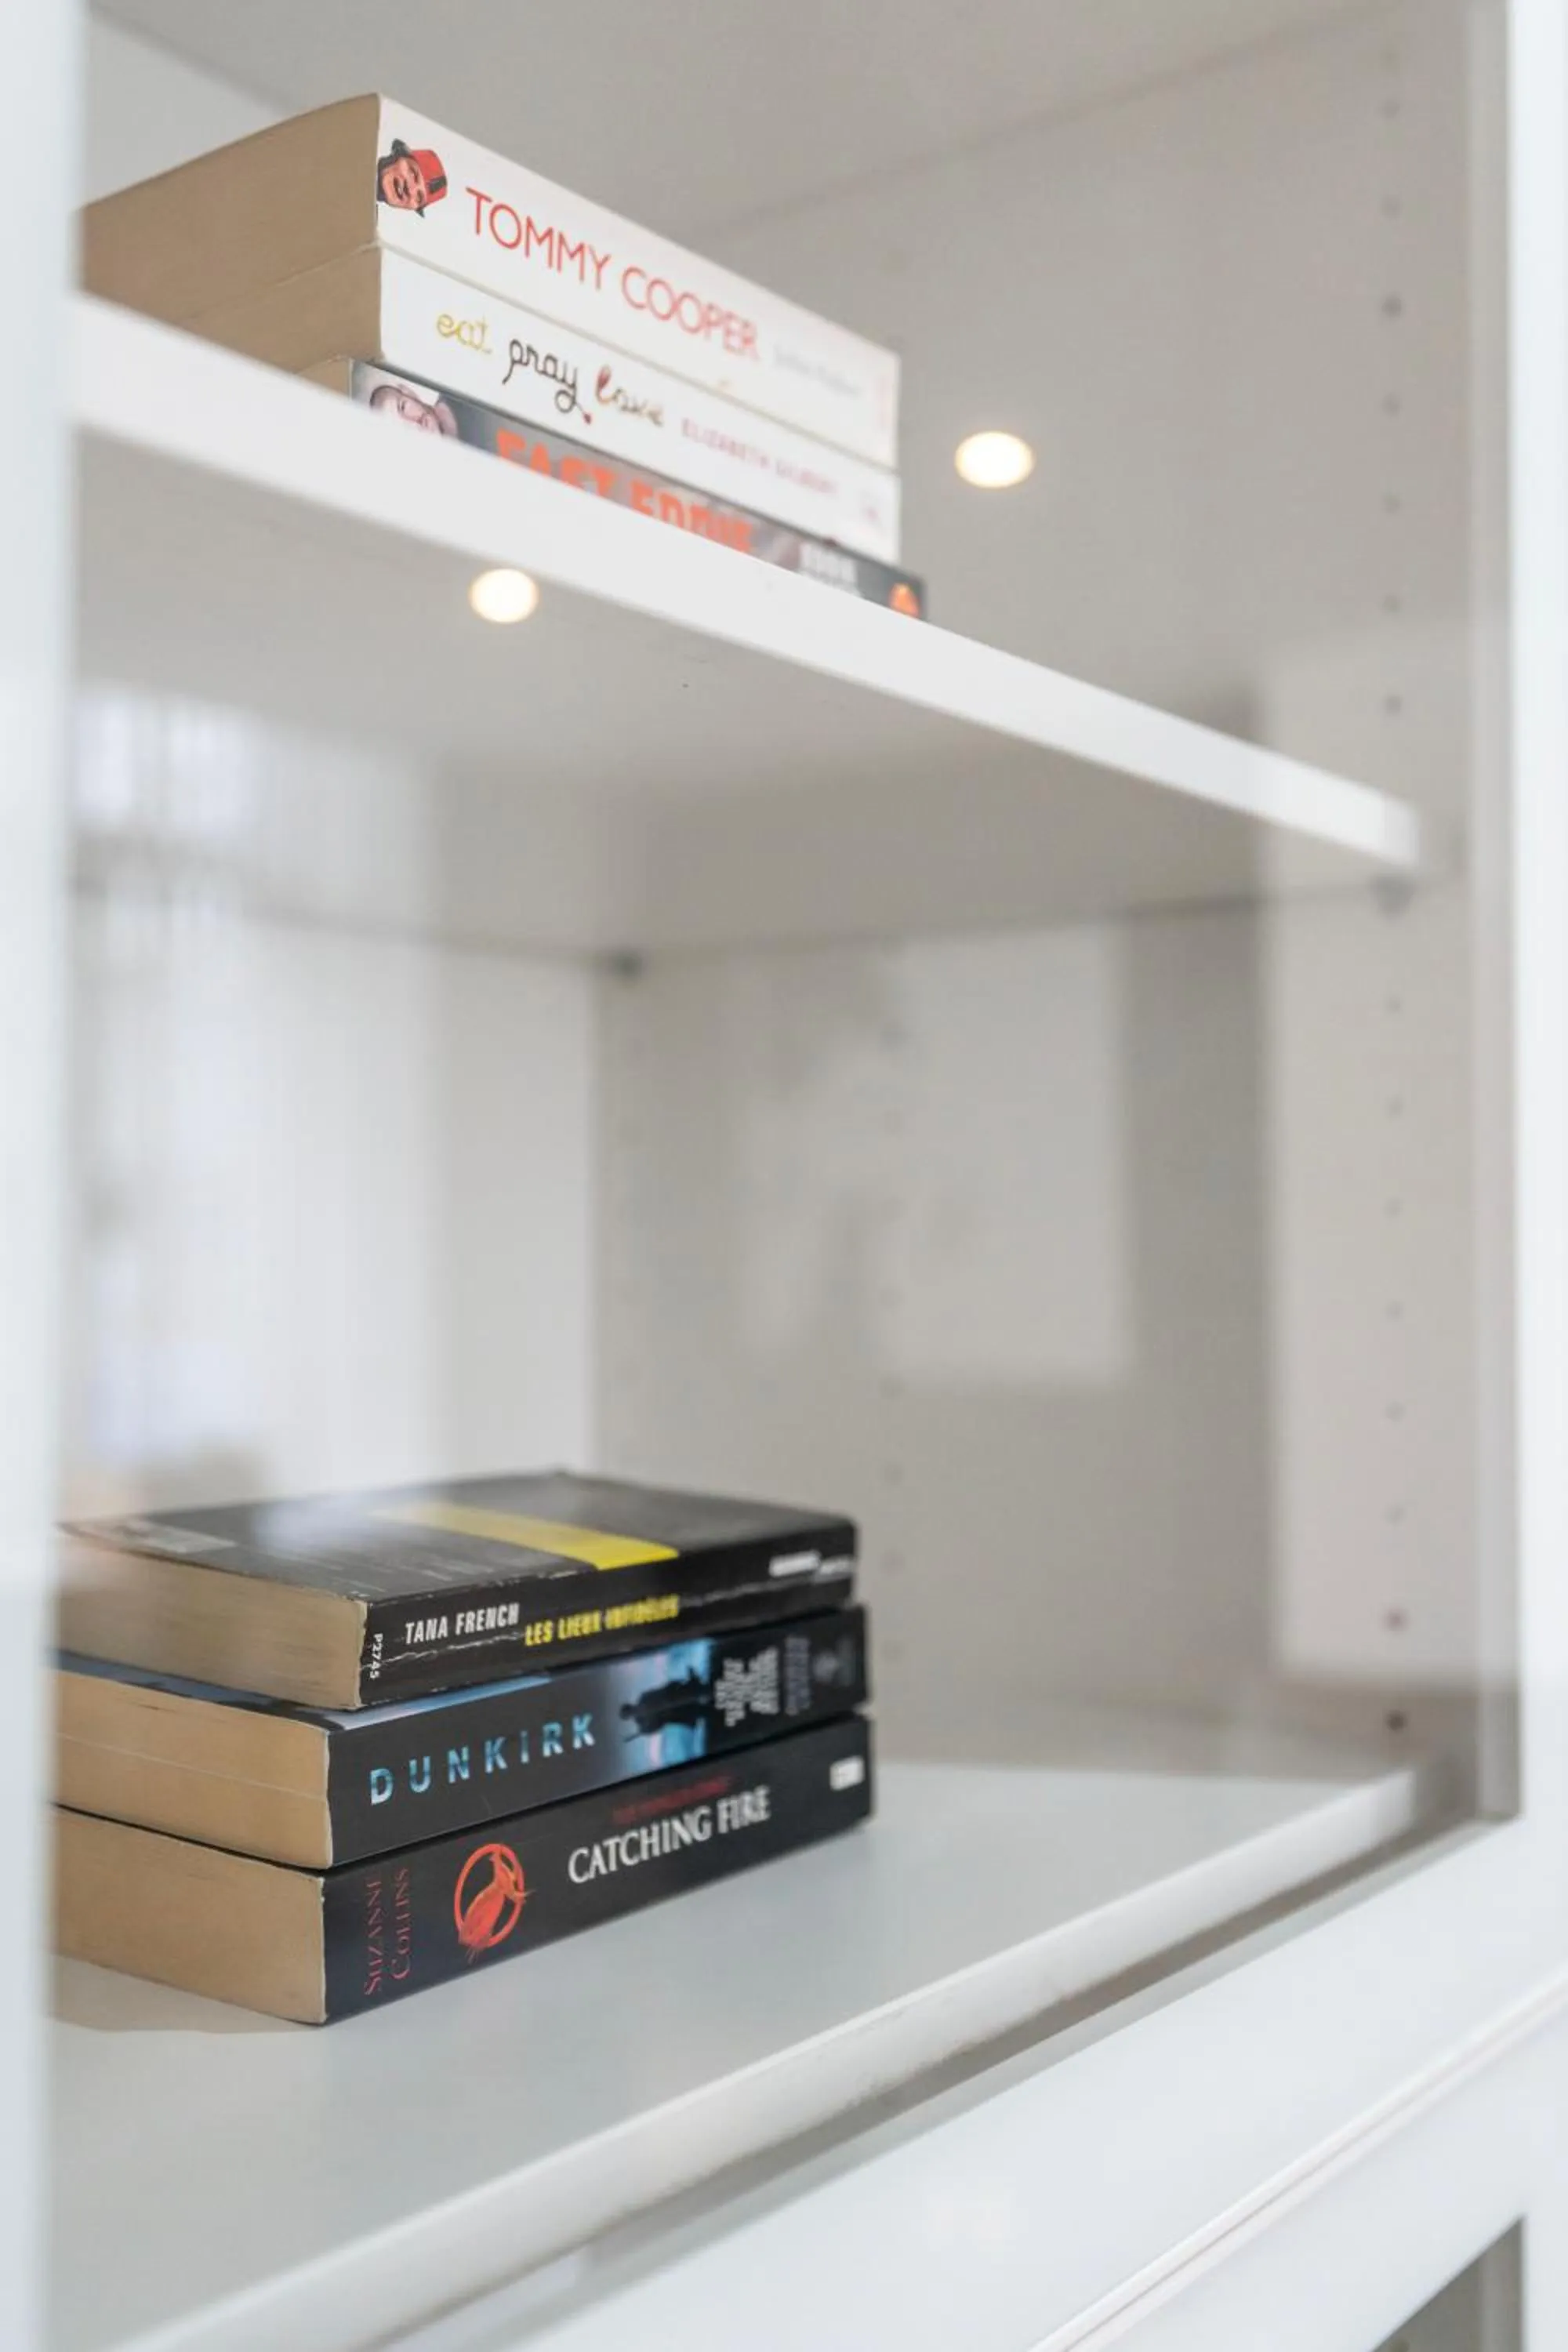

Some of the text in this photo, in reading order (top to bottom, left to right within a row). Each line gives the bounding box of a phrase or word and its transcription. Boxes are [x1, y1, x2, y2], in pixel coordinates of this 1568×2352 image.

[466, 186, 759, 361] TOMMY COOPER
[436, 313, 664, 426] eat pray love
[369, 1633, 383, 1679] P2745
[405, 1602, 520, 1645] TANA FRENCH
[524, 1620, 552, 1646] LES
[557, 1610, 601, 1639] LIEUX
[369, 1713, 595, 1806] DUNKIRK
[568, 1805, 711, 1884] CATCHING
[717, 1784, 771, 1834] FIRE
[364, 1877, 383, 1994] SUZANNE
[391, 1868, 411, 1980] COLLINS
